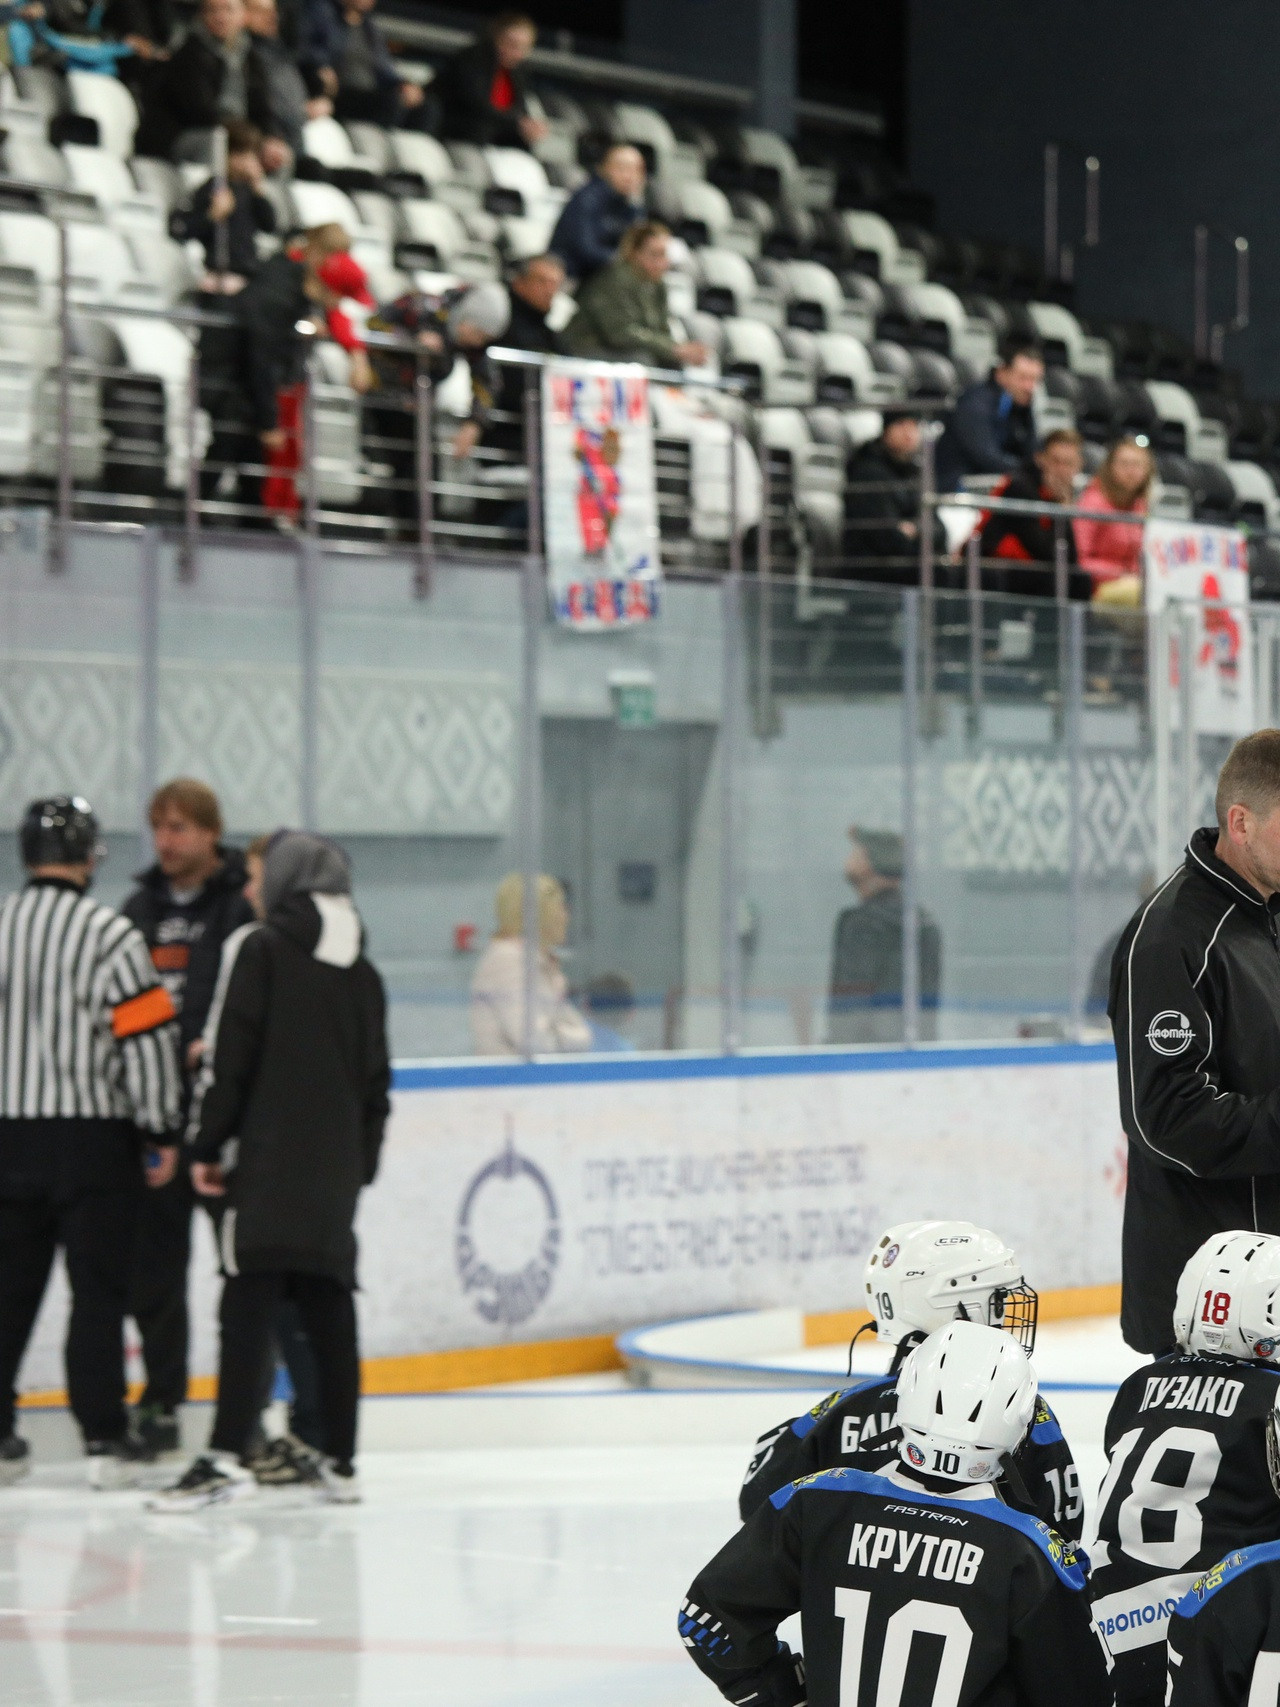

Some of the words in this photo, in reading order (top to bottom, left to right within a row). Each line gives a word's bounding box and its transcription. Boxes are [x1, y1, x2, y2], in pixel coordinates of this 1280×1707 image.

[875, 1292, 894, 1321] 19
[1201, 1289, 1231, 1326] 18
[1138, 1375, 1245, 1418] ПУЗАКО
[932, 1449, 961, 1475] 10
[1043, 1463, 1083, 1523] 19
[1087, 1426, 1222, 1571] 18
[883, 1504, 969, 1527] FASTRAN
[847, 1522, 985, 1586] КРУТОВ
[1099, 1596, 1184, 1637] ВОПОЛО
[834, 1586, 974, 1707] 10
